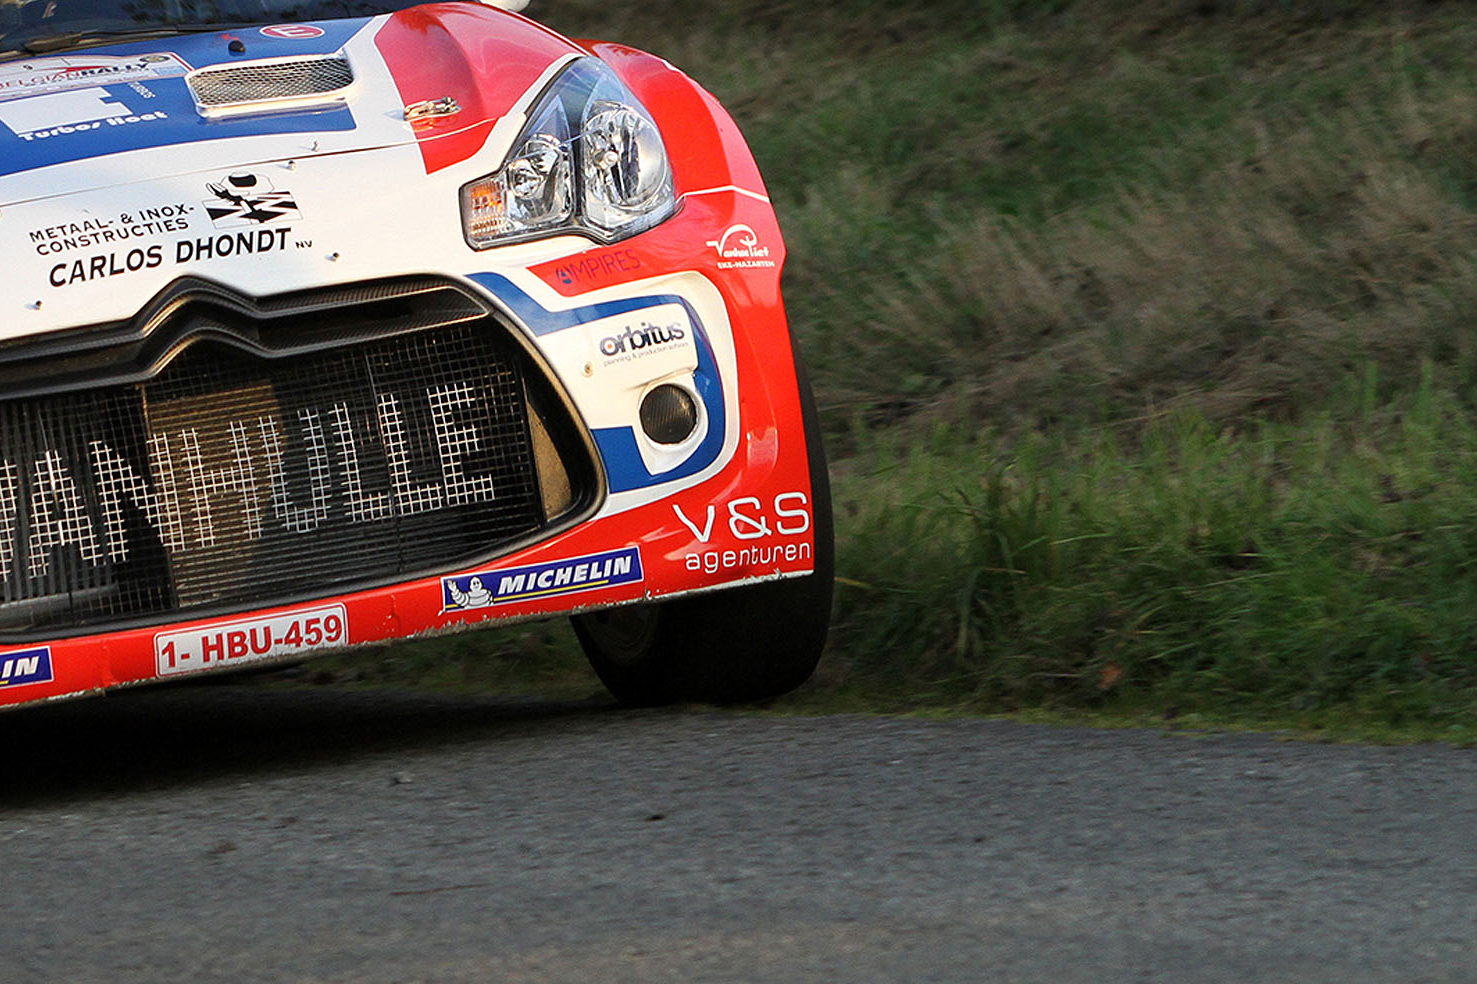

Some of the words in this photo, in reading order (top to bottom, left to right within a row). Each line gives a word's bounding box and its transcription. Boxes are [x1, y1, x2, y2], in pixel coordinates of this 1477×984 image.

[19, 121, 101, 142] Turbos
[107, 110, 169, 127] Hoet
[29, 218, 114, 243] METAAL-
[120, 212, 135, 225] &
[138, 203, 195, 222] INOX-
[36, 218, 190, 256] CONSTRUCTIES
[49, 245, 164, 288] CARLOS
[175, 227, 292, 264] DHONDT
[295, 239, 313, 249] NV
[599, 321, 685, 357] orbitus
[672, 491, 811, 544] V&S
[497, 554, 633, 595] MICHELIN
[684, 541, 812, 574] agenturen
[201, 613, 343, 664] HBU-459
